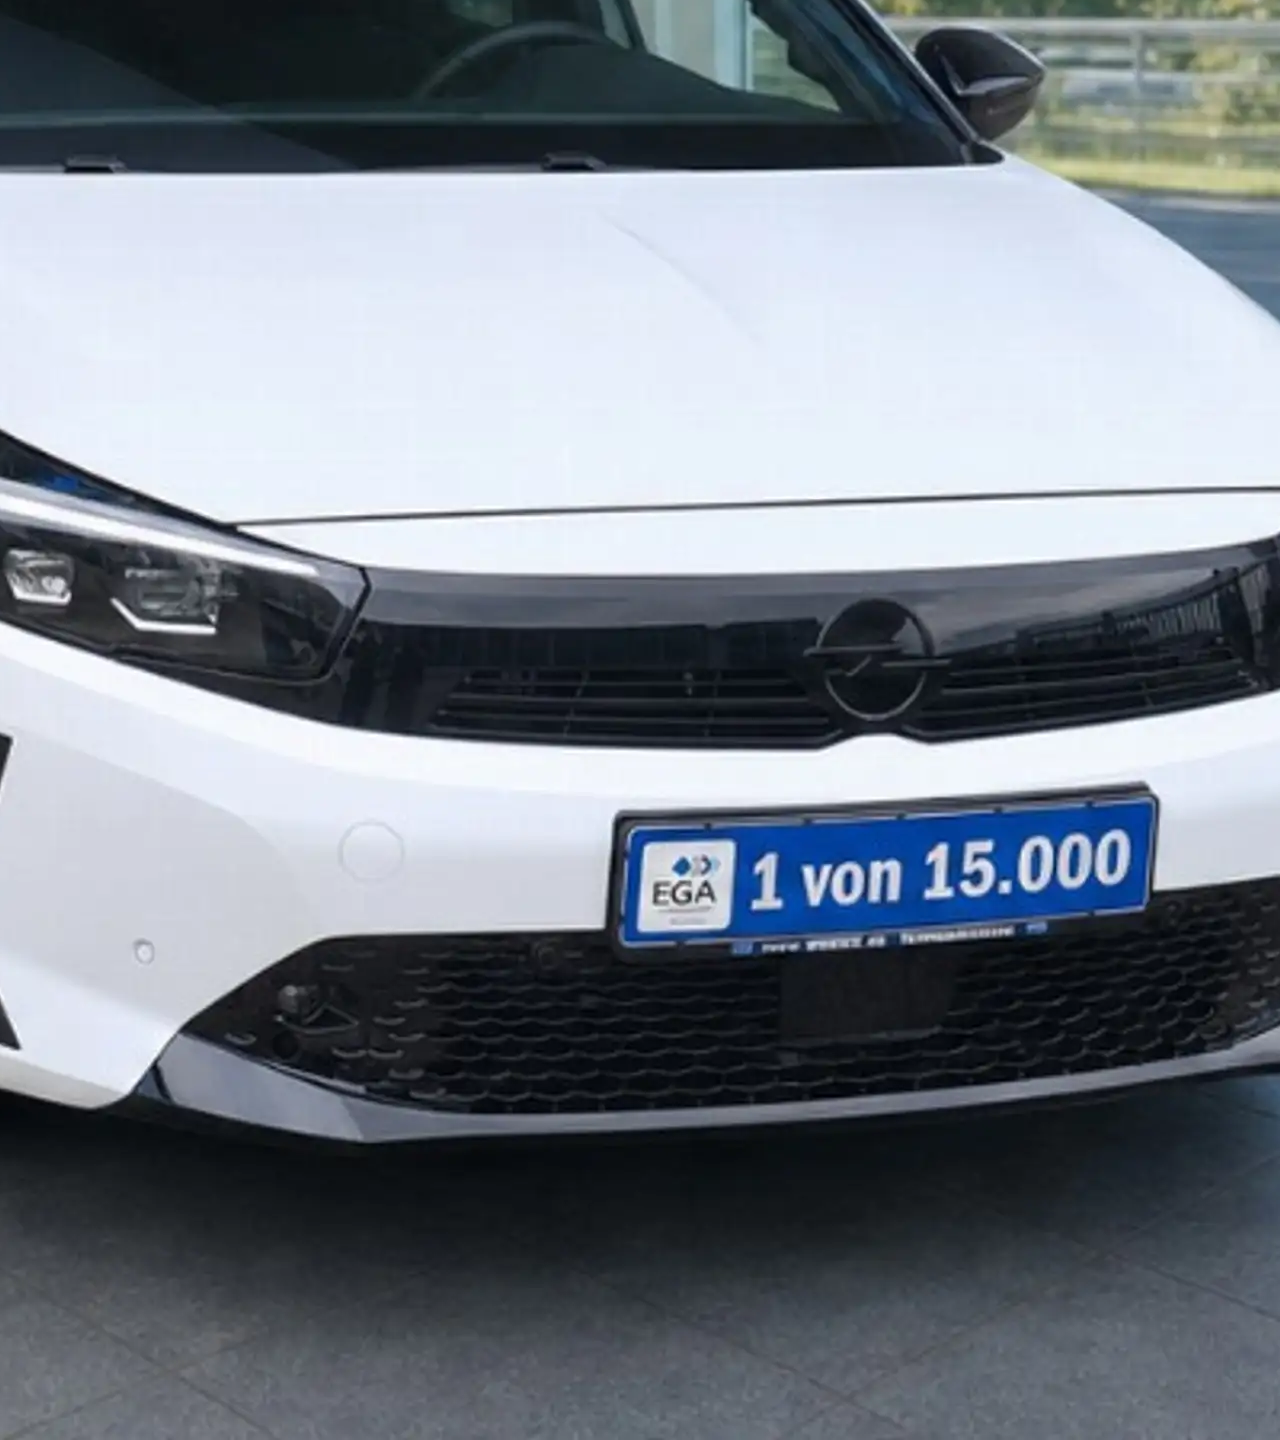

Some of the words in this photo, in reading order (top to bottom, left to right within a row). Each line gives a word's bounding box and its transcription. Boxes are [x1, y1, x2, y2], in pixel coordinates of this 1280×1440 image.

[652, 879, 718, 907] EGA
[750, 852, 783, 911] 1
[801, 859, 902, 907] von
[923, 828, 1133, 902] 15.000
